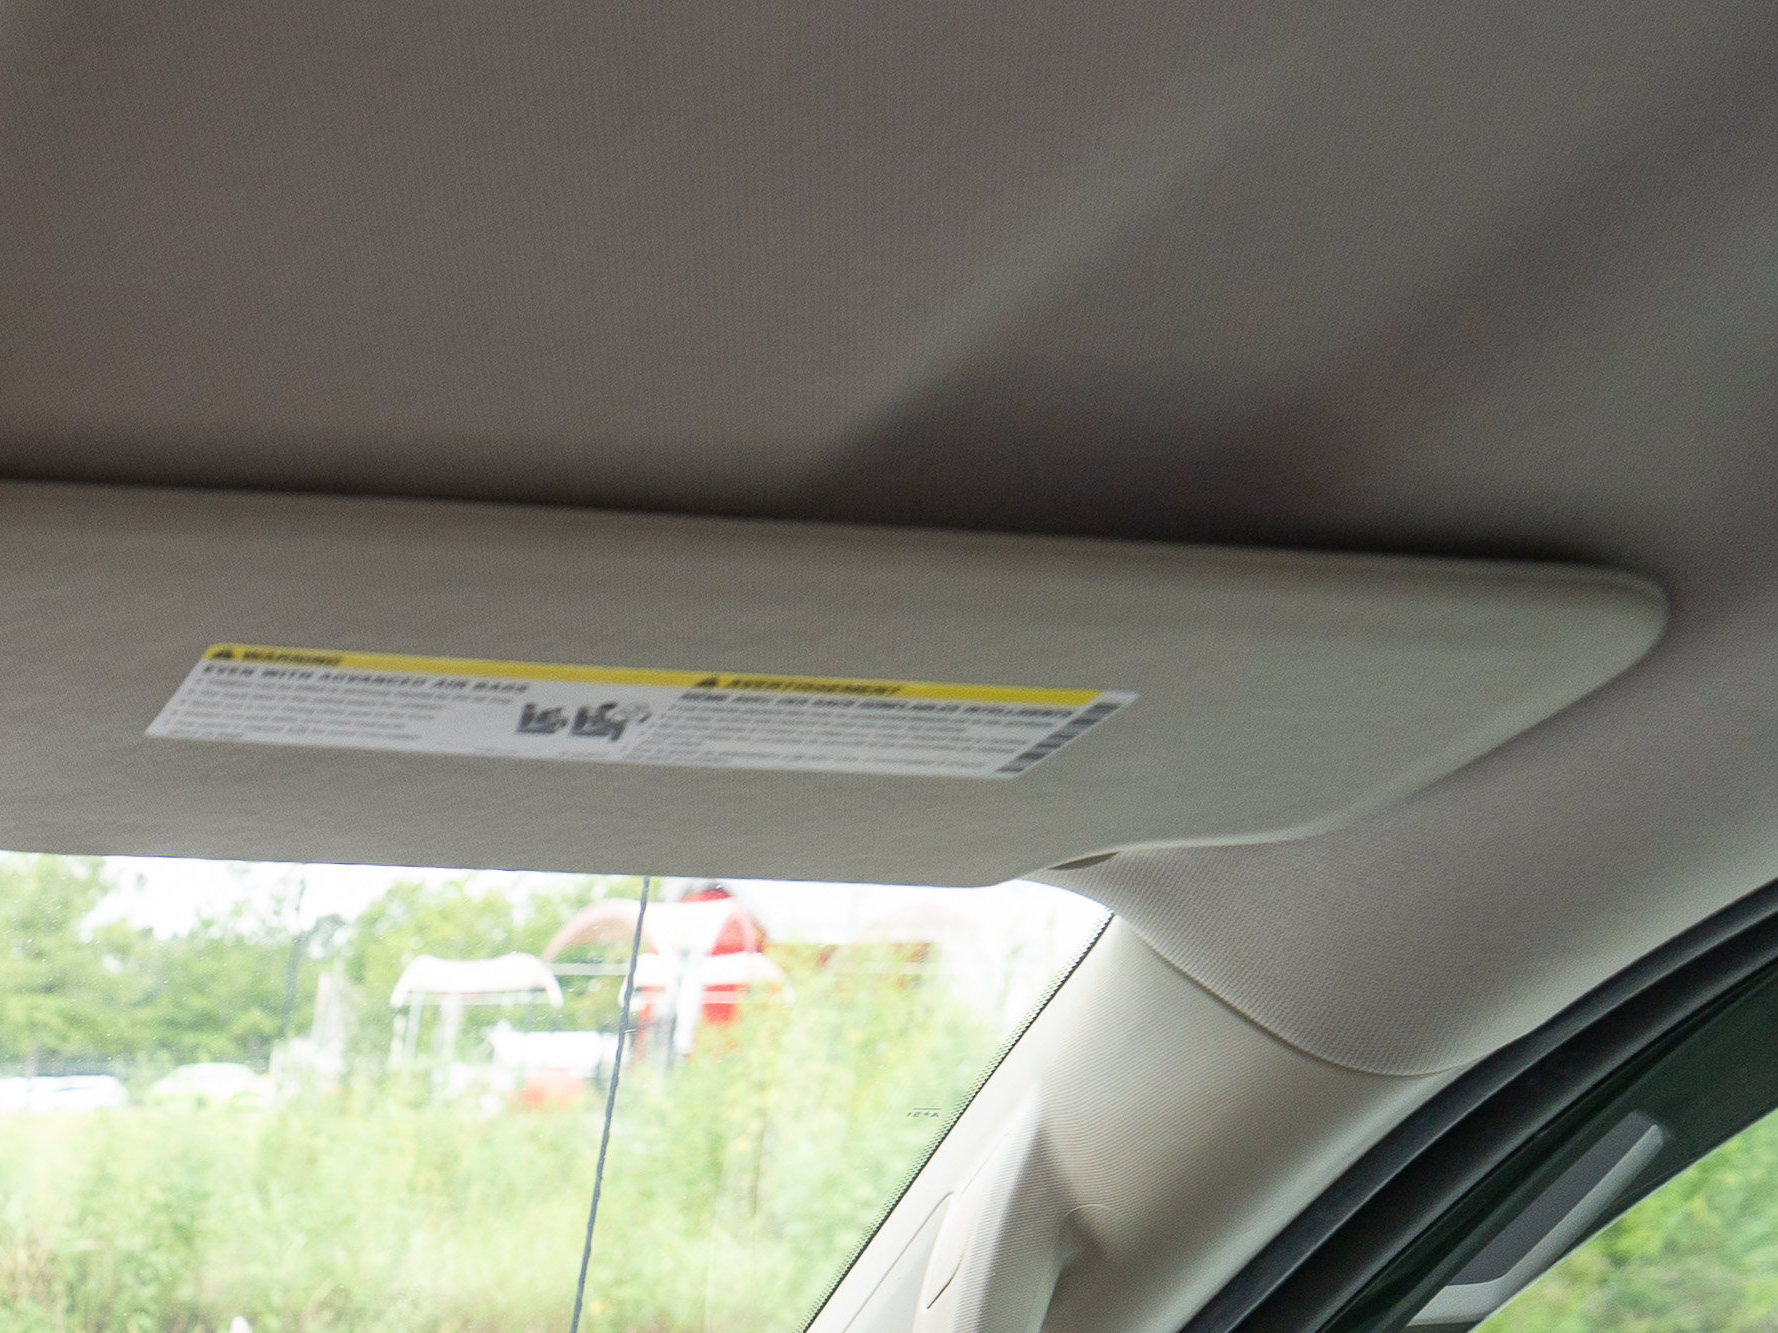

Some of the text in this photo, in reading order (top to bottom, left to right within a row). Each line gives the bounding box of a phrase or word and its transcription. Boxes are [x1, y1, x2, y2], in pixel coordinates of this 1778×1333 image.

[202, 663, 254, 678] EVEN
[260, 667, 314, 682] WITH
[318, 671, 428, 688] ADVANCED
[432, 678, 468, 691] AIR
